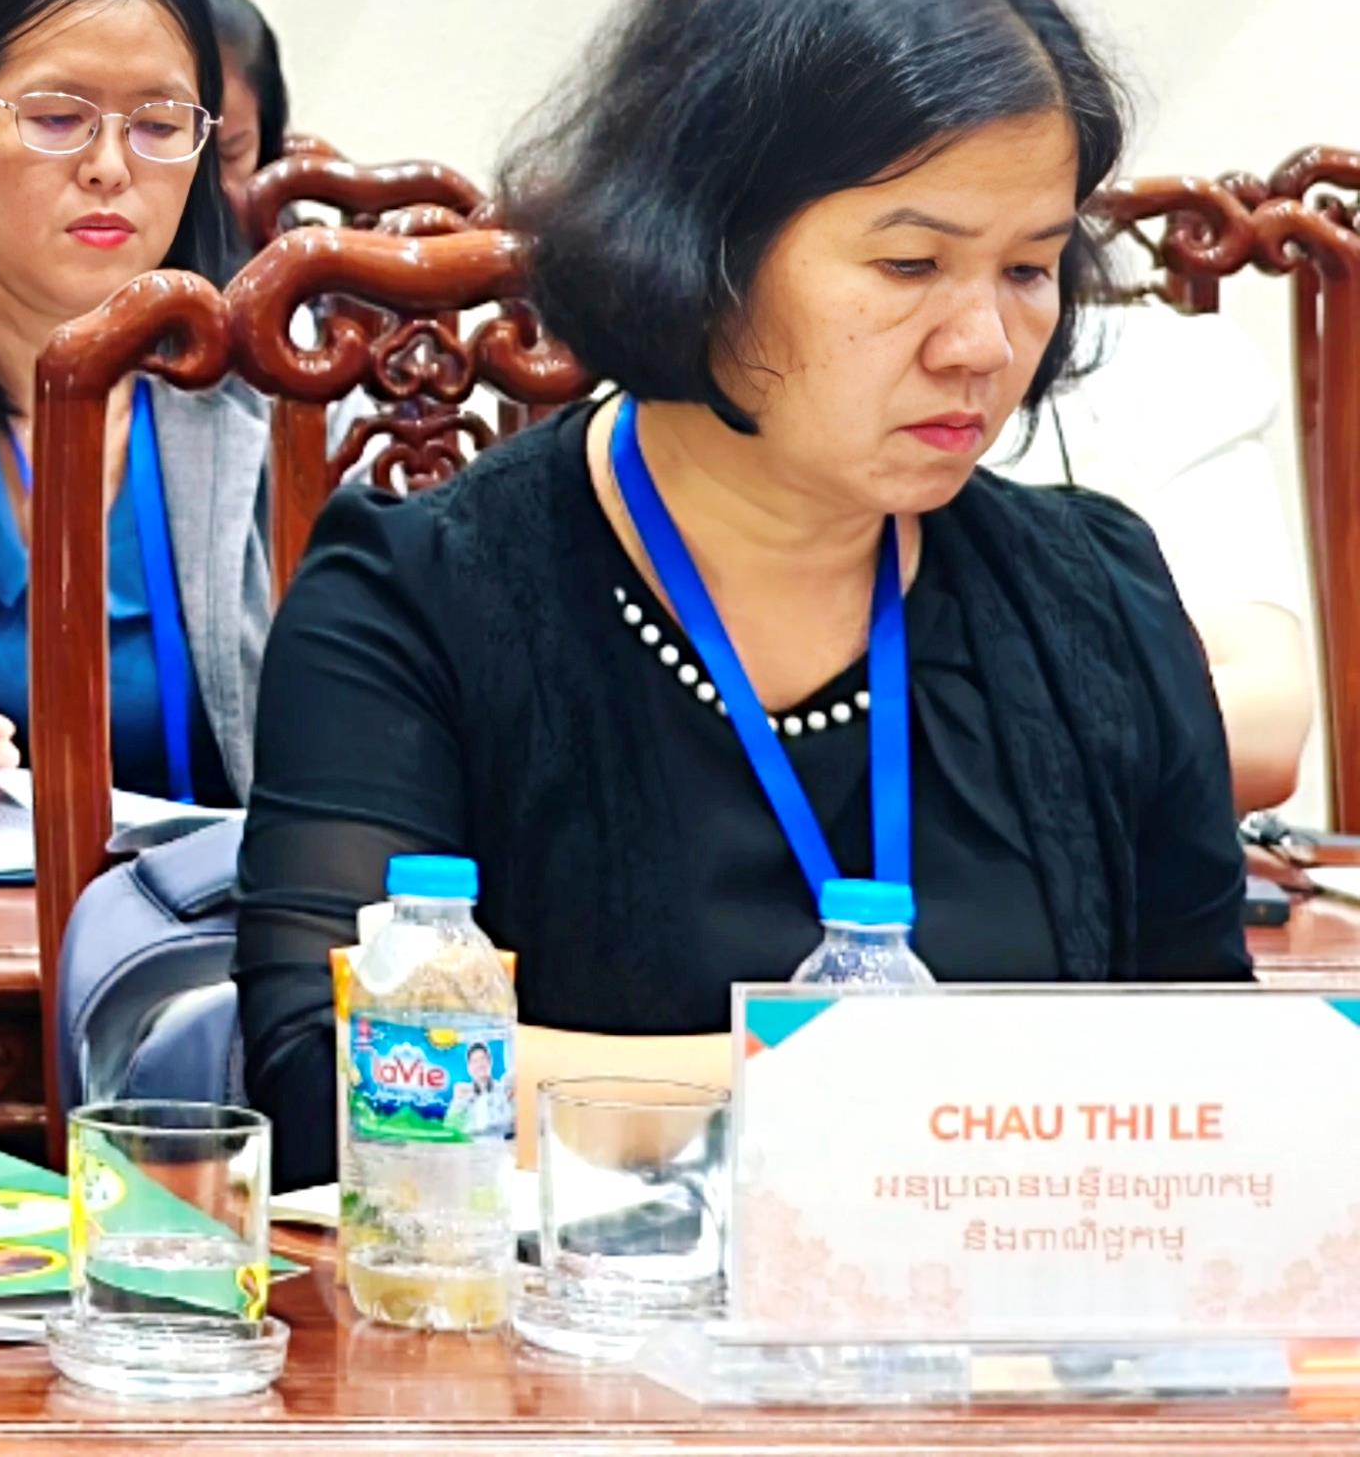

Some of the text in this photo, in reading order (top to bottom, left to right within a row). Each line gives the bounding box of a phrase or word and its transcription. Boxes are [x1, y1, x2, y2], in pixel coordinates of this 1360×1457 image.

[930, 1104, 1223, 1141] CHAU THI LE
